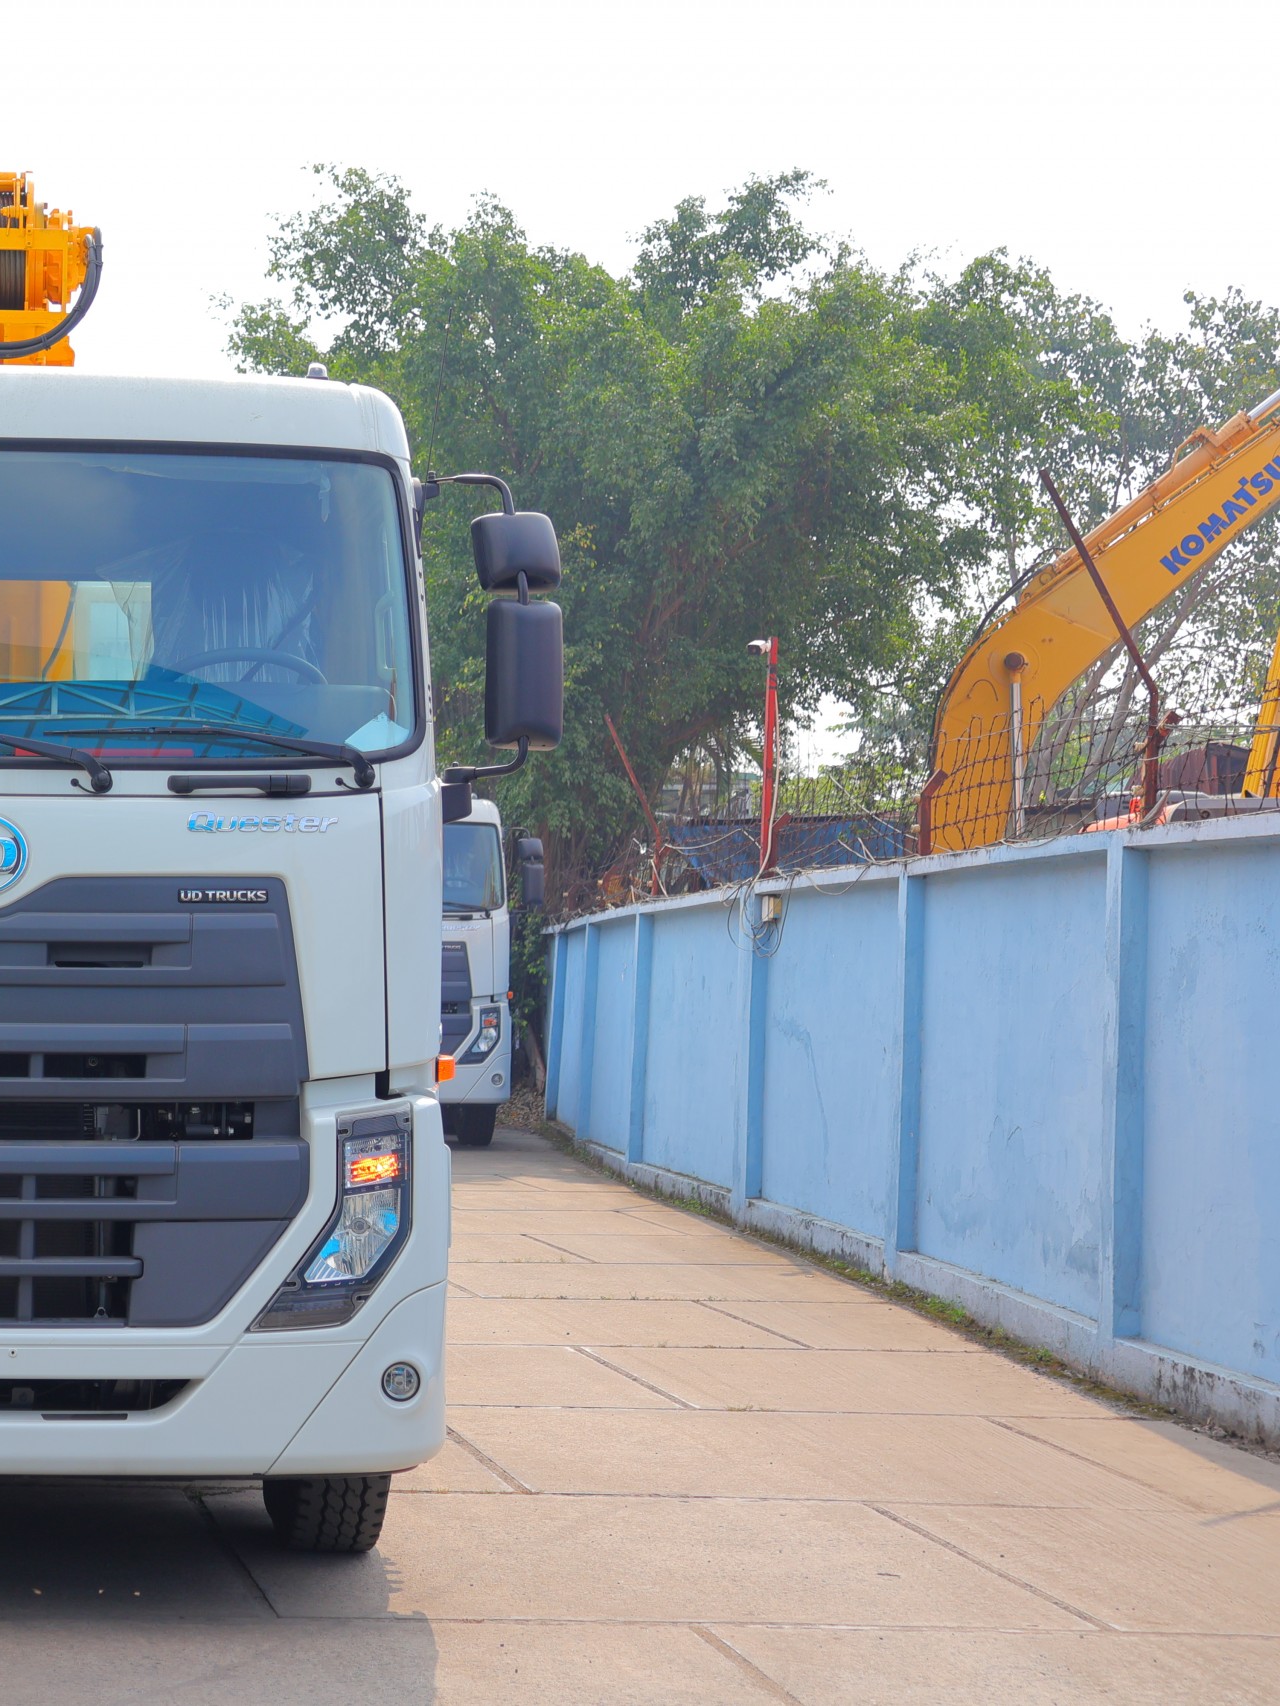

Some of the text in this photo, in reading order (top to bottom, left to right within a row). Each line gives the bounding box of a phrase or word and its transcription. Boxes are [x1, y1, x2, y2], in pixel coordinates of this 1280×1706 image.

[187, 810, 339, 833] Quester
[181, 890, 267, 902] UD TRUCKS
